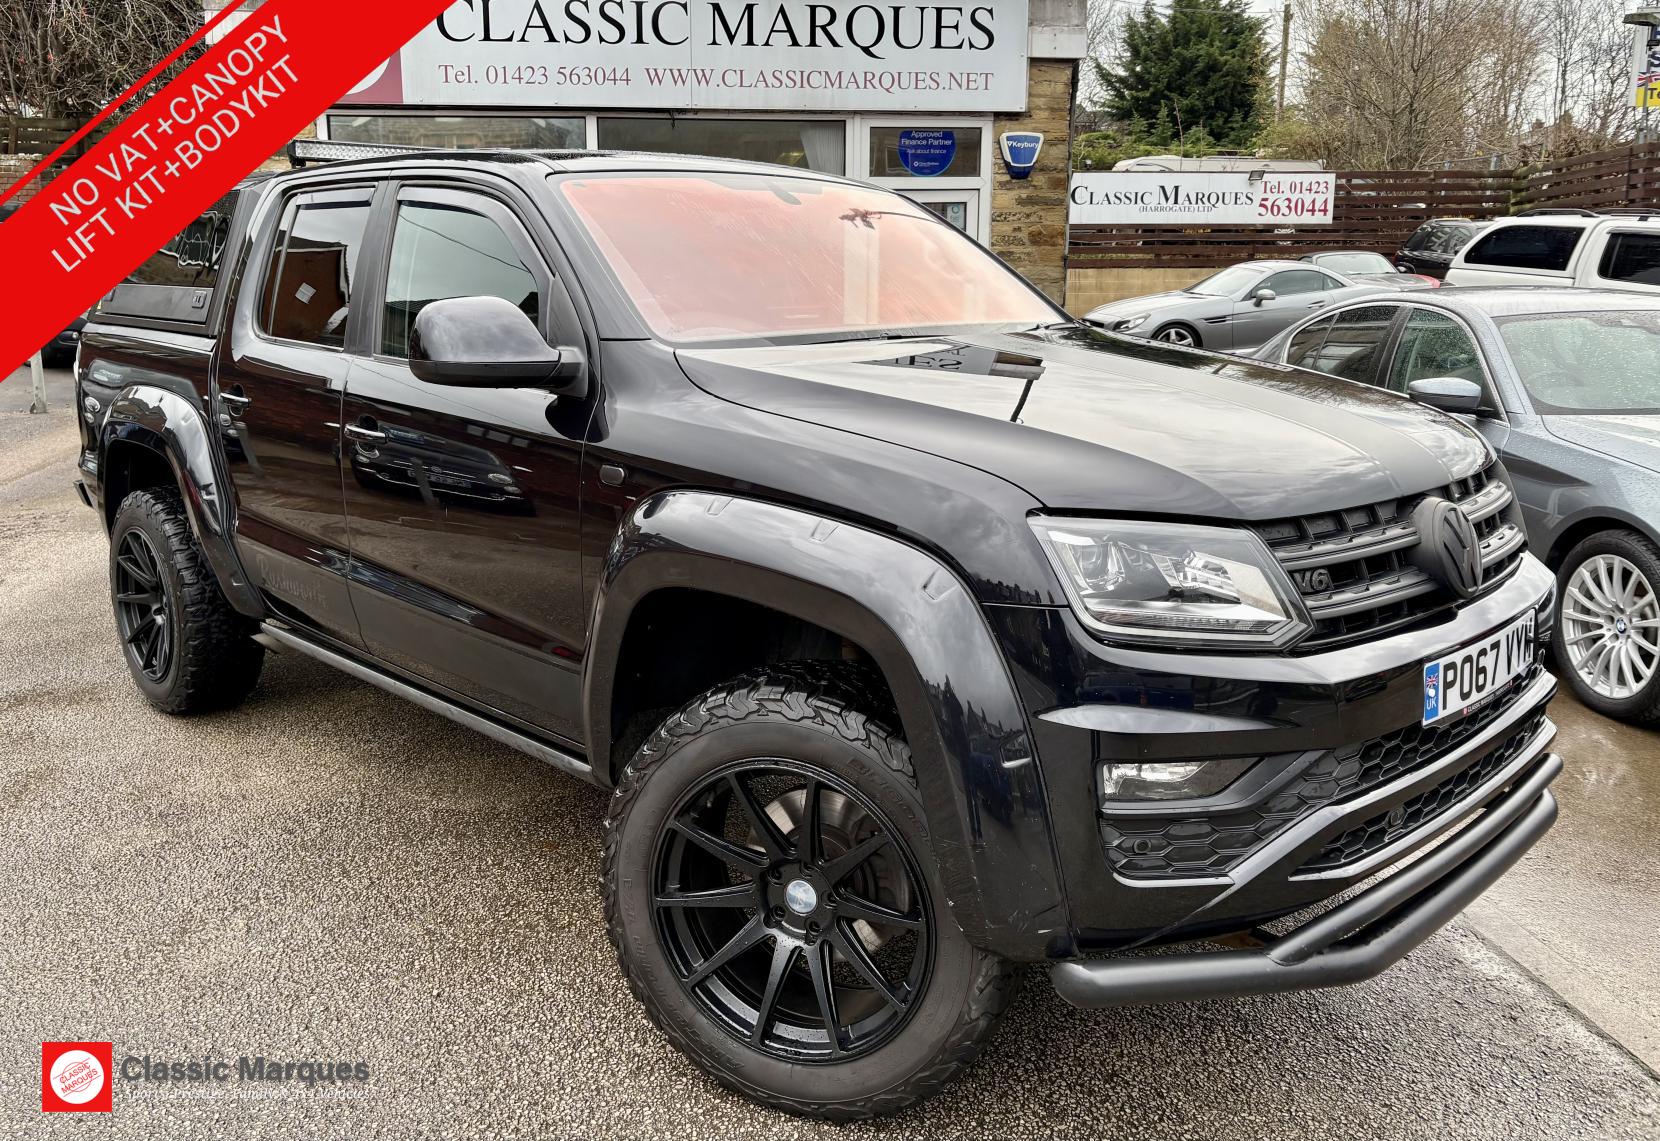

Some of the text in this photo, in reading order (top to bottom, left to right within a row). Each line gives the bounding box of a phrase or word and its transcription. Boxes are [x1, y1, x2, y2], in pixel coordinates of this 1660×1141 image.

[436, 0, 996, 60] CLASSIC MARQUES
[438, 64, 995, 94] Tel. 01423 563044 WWW.CLASSICMARQUES.NET
[911, 130, 943, 138] Approved
[928, 138, 953, 146] Partner
[1012, 141, 1039, 149] Keybury
[1261, 181, 1329, 195] Tel. 01423
[1070, 185, 1255, 209] CLASSIC MARQUES
[1138, 205, 1213, 213] (HARROGATE) LTD
[1257, 197, 1329, 217] 563044
[1442, 639, 1501, 711] PO67
[1426, 697, 1437, 710] UK
